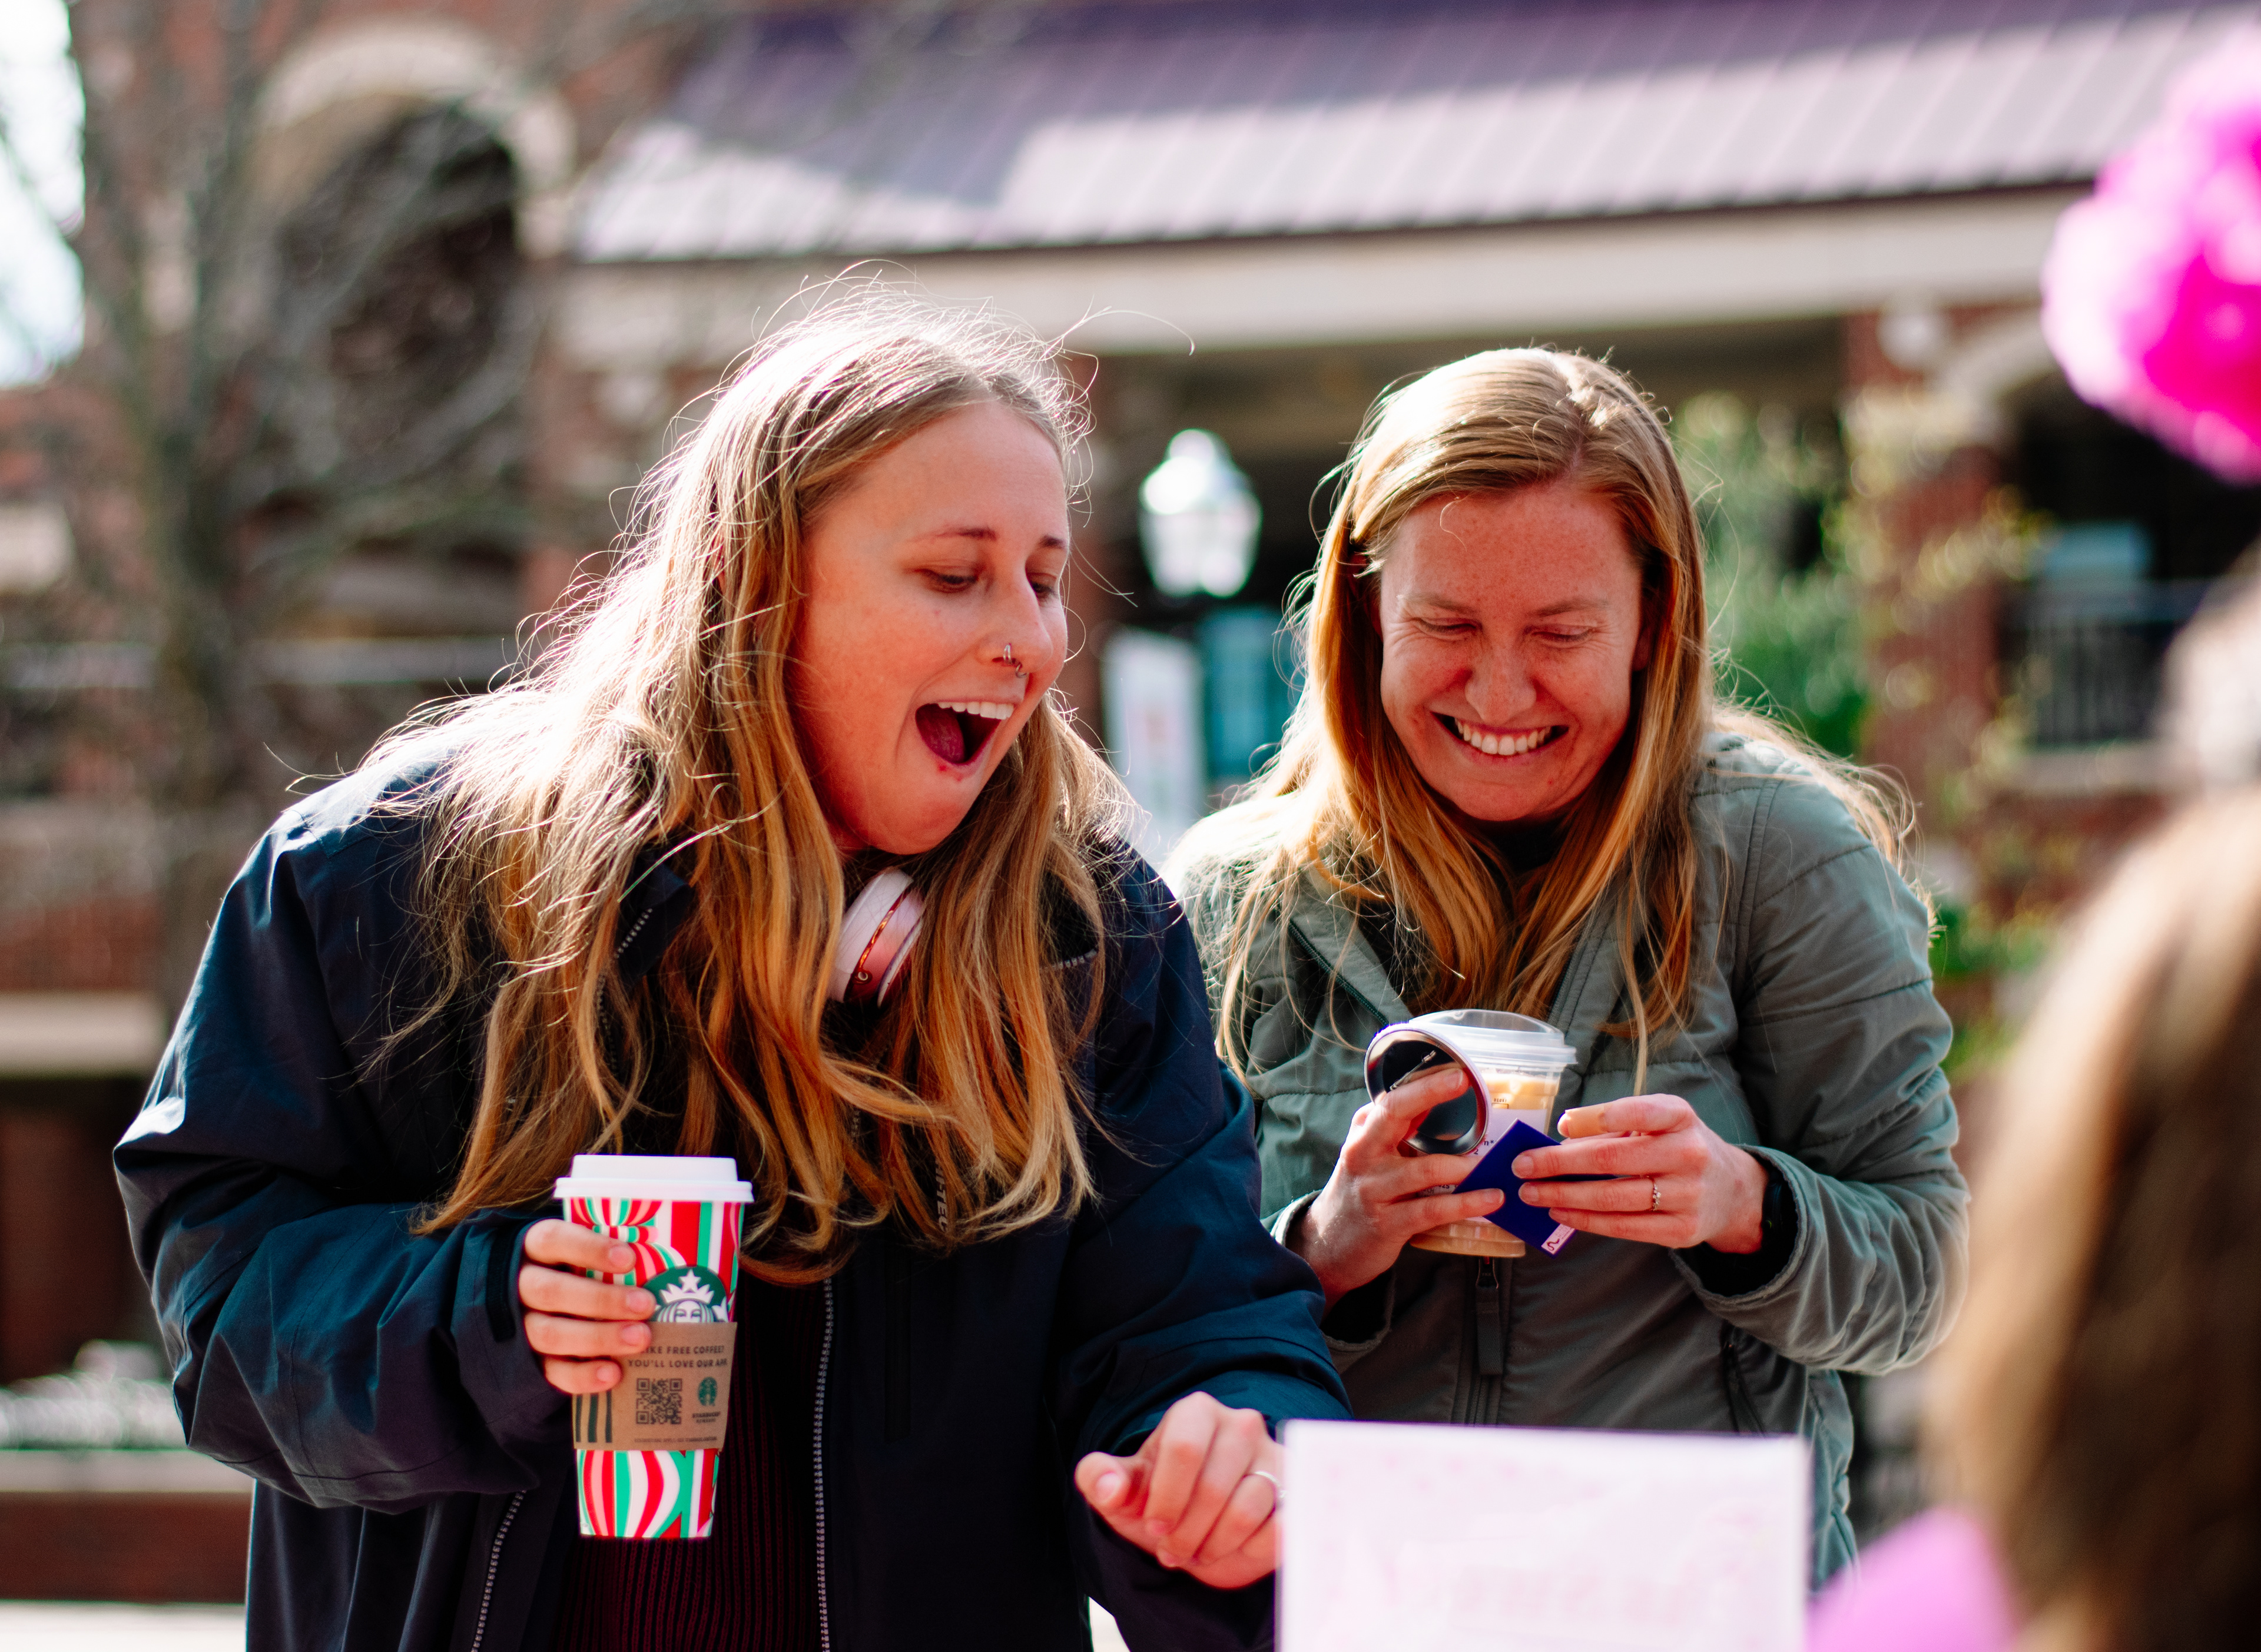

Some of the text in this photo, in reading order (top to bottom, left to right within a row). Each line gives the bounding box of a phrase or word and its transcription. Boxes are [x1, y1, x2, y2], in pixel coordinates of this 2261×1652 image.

[644, 1345, 725, 1354] IKE FREE COFFEE?
[628, 1359, 665, 1368] YOU'LL
[669, 1359, 694, 1368] LOVE
[697, 1359, 714, 1368] OUR
